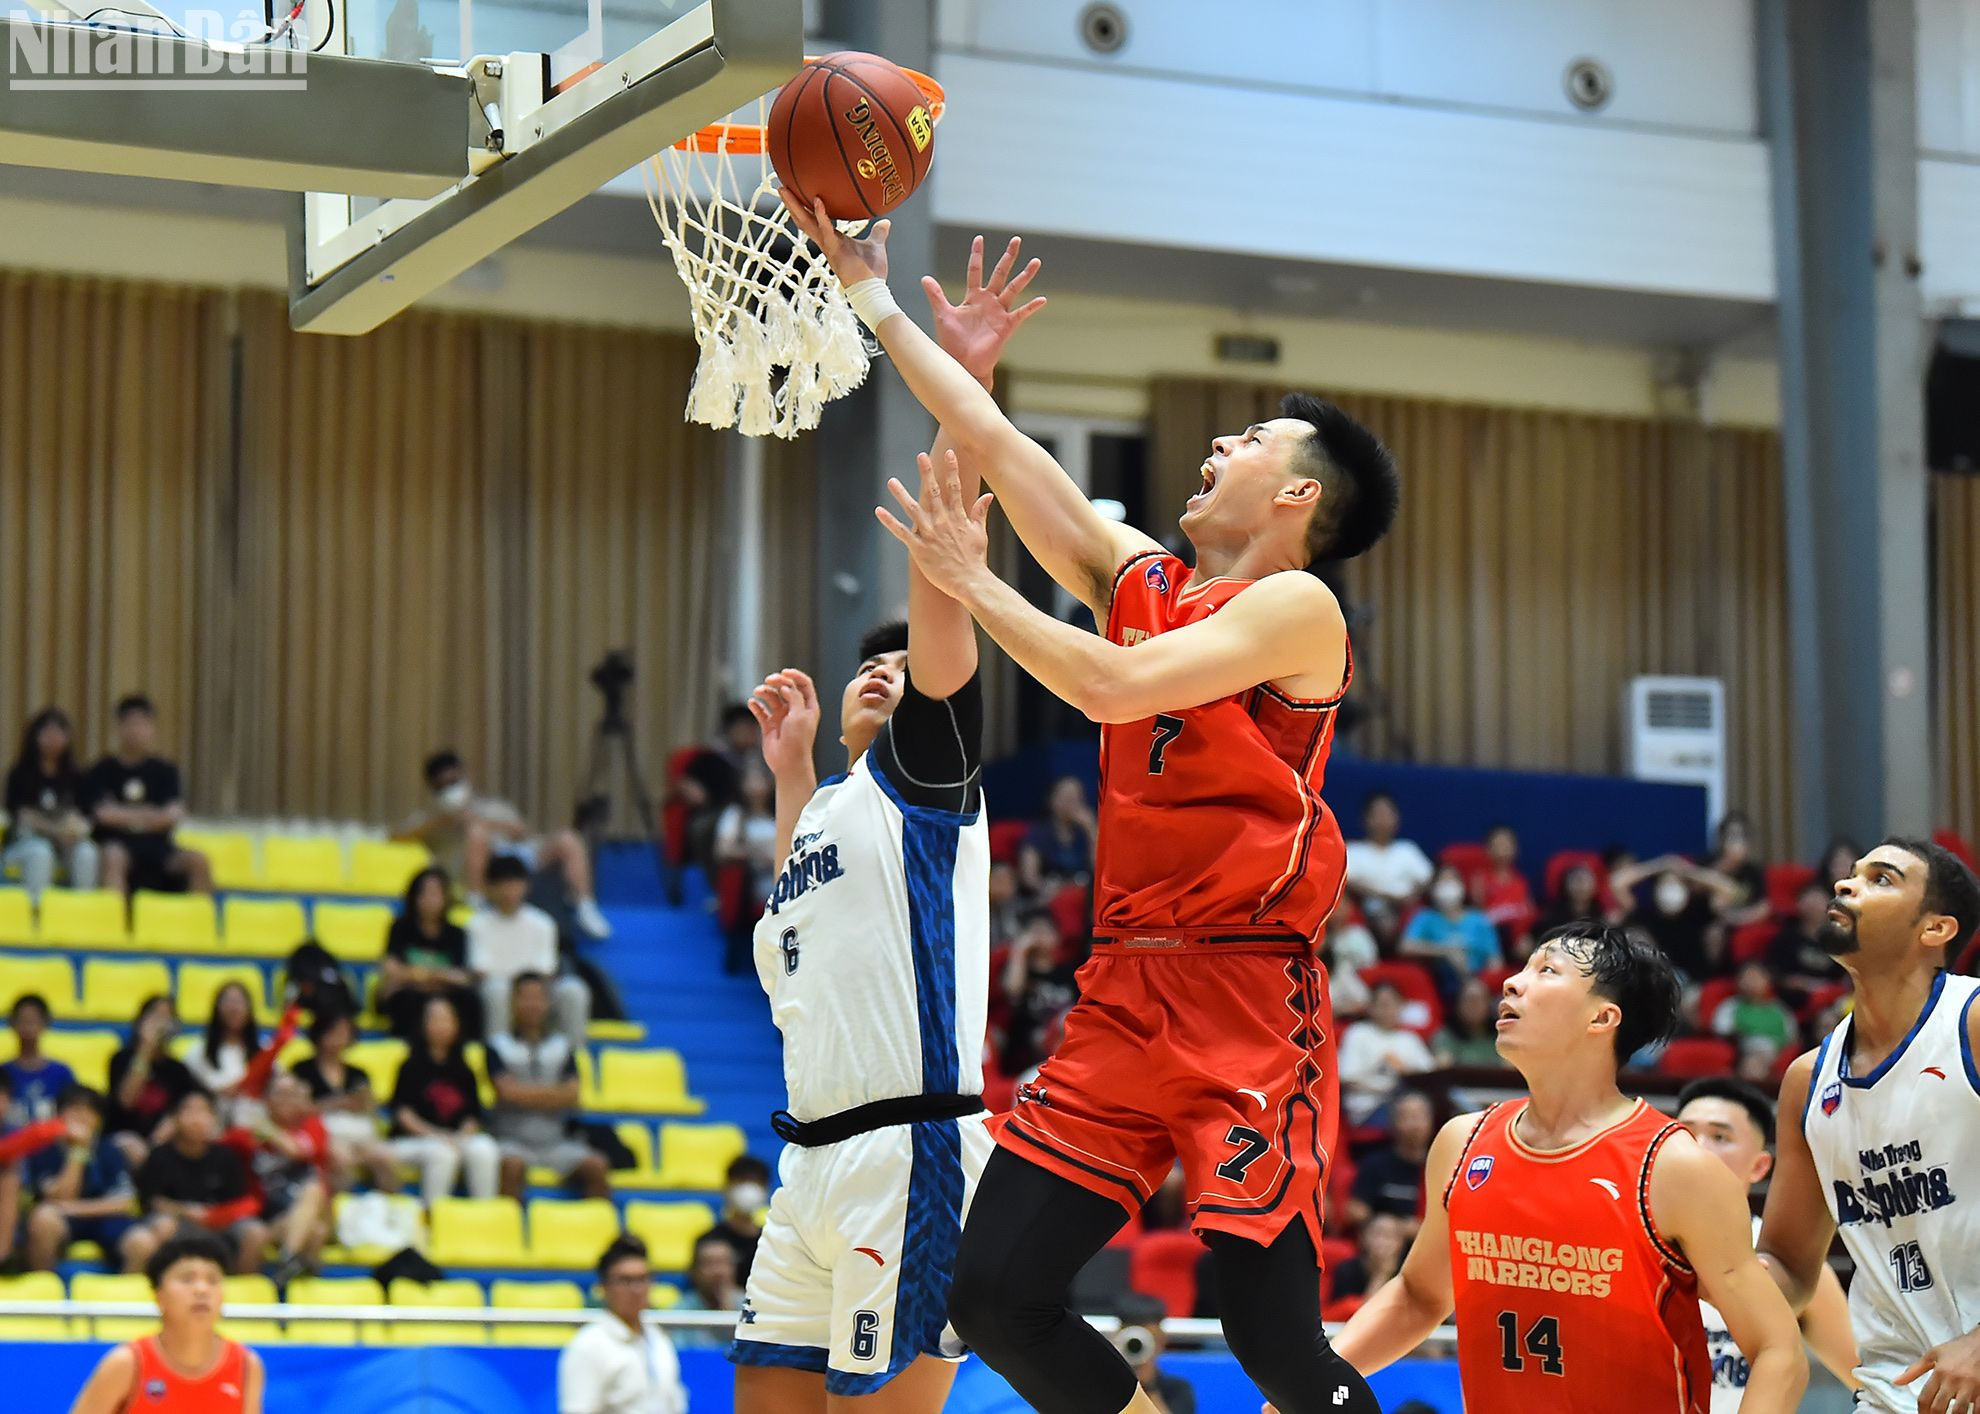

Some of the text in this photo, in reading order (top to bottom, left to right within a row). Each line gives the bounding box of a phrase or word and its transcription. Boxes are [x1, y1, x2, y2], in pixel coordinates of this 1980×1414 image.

[1149, 714, 1185, 776] 7
[779, 925, 800, 977] 6
[1216, 1125, 1271, 1184] 7
[1455, 1230, 1623, 1272] THANGLONG
[1889, 1240, 1934, 1293] 13
[850, 1309, 879, 1361] 6
[1497, 1311, 1565, 1377] 14
